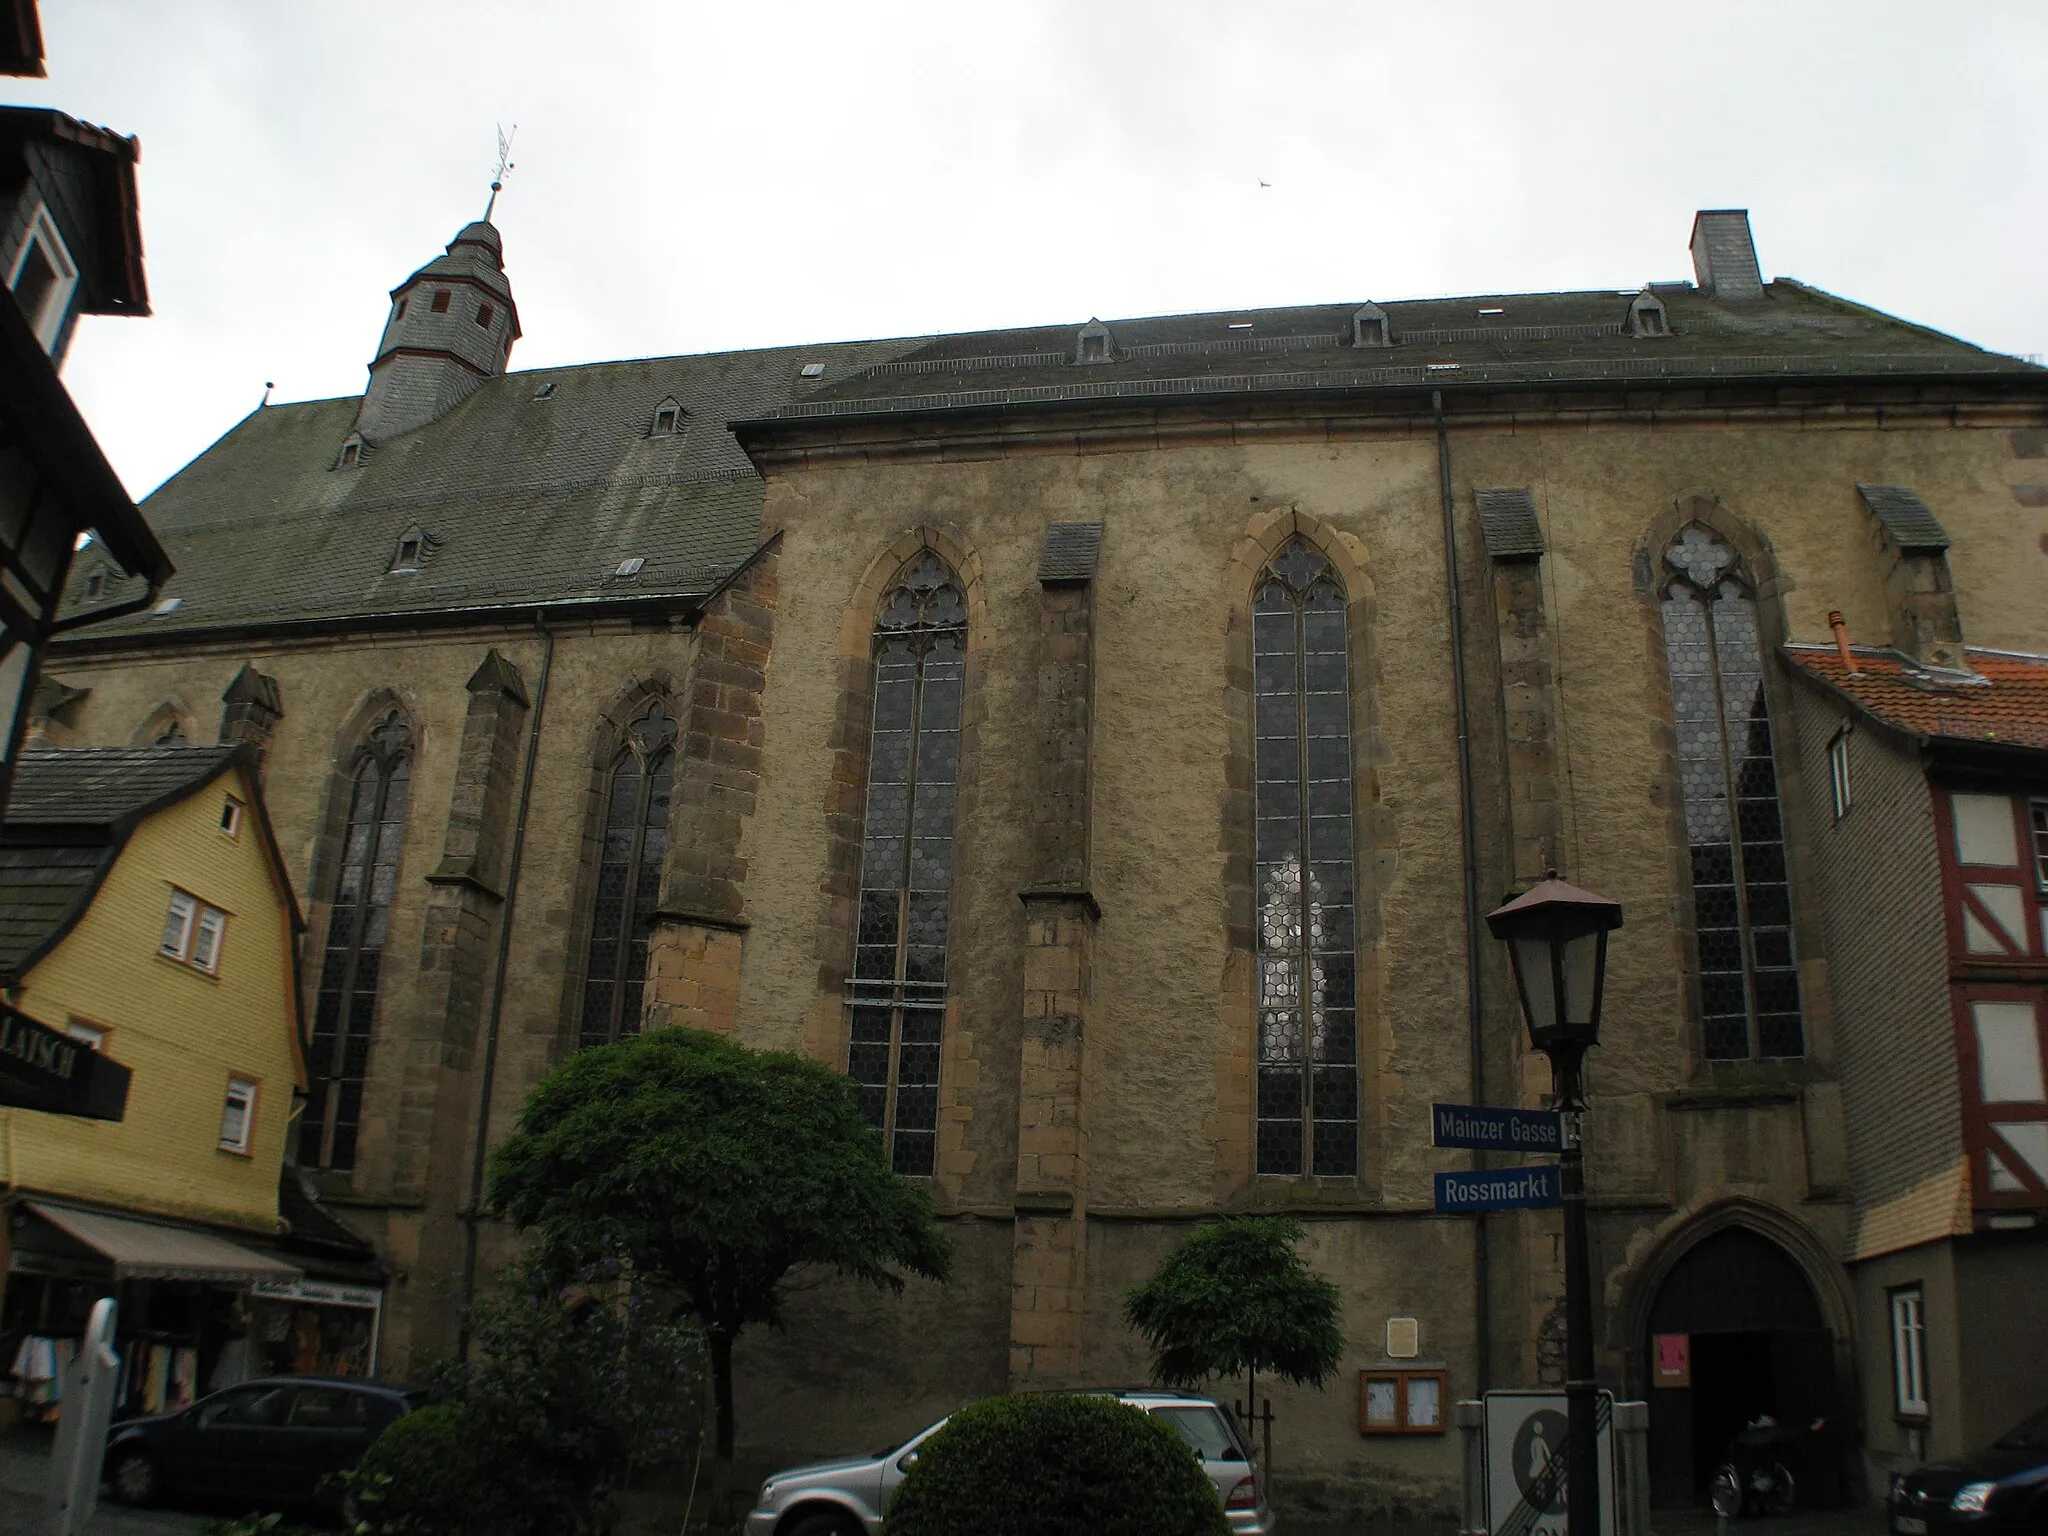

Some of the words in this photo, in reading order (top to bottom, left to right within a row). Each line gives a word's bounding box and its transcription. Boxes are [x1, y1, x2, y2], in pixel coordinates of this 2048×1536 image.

[1440, 1111, 1505, 1141] Mainzer
[1510, 1116, 1557, 1143] Gasse
[1445, 1173, 1549, 1203] Rossmarkt
